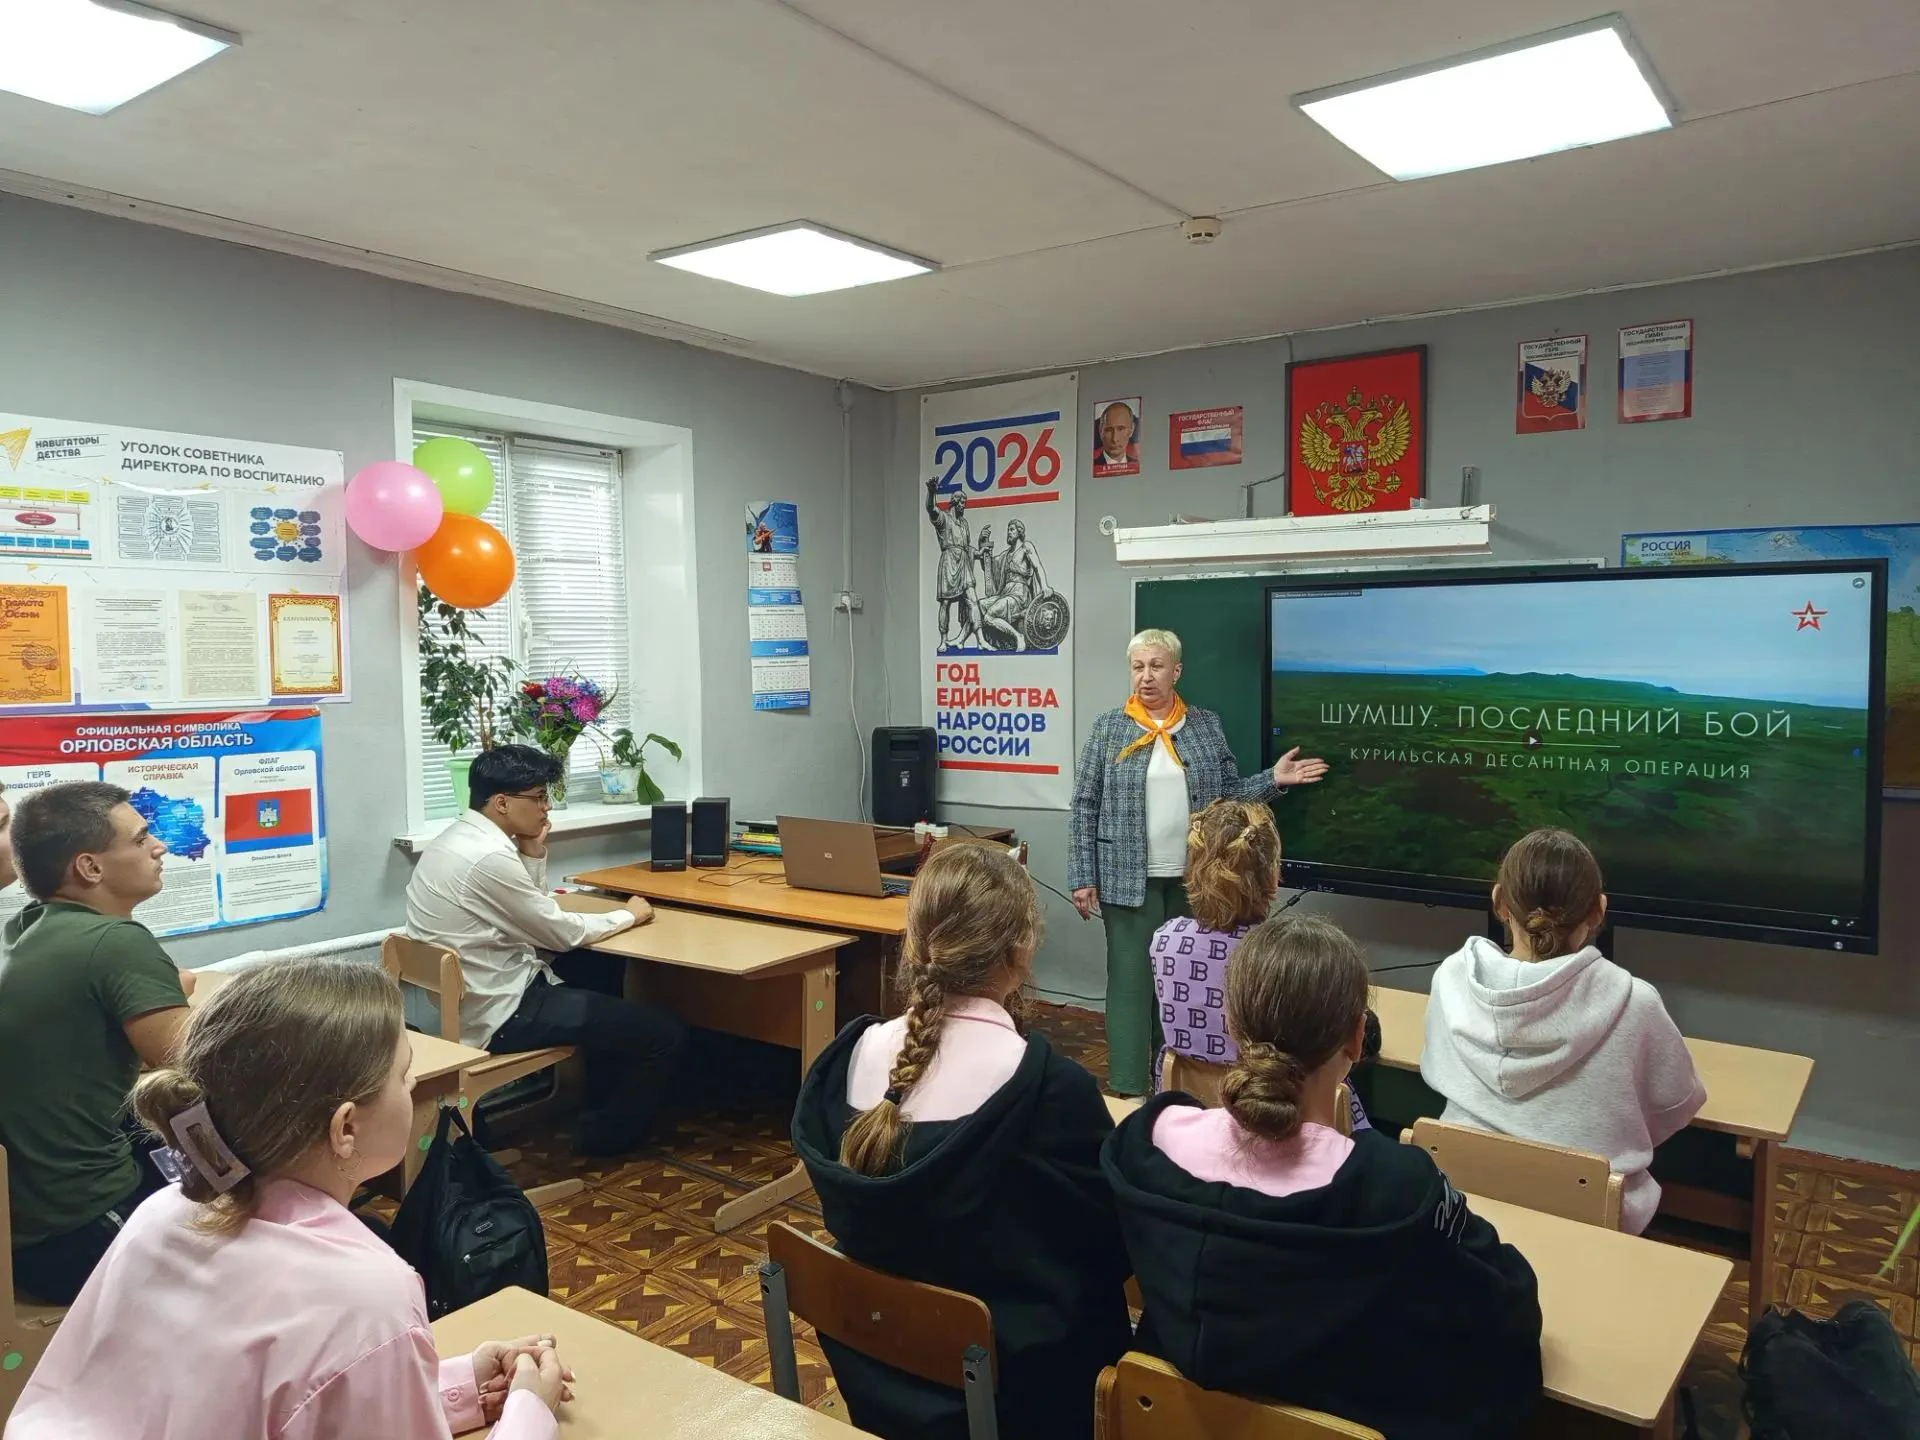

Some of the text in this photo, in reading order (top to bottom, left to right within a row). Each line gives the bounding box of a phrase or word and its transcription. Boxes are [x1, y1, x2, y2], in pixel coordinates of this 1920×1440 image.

[35, 436, 100, 449] НАВИГАТОРЫ
[120, 440, 265, 466] УГОЛОК СОВЕТНИКА
[37, 448, 81, 461] ДЕТСТВА
[935, 428, 1061, 495] 2026
[121, 458, 325, 487] ДИРЕКТОРА ПО ВОСПИТАНИЮ
[1641, 540, 1691, 552] РОССИЯ
[936, 663, 981, 686] ГОД
[936, 687, 1060, 710] ЕДИНСТВА
[76, 721, 242, 737] ОФИЦИАЛЬНАЯ СИМВОЛИКА
[937, 711, 1046, 736] НАРОДОВ
[1320, 703, 1792, 739] ШУМШУ. ПОСЛЕДНИЙ БОЙ
[60, 735, 254, 754] ОРЛОВСКАЯ ОБЛАСТЬ
[937, 734, 1031, 758] РОССИИ
[27, 770, 52, 779] ГЕРБ
[127, 762, 199, 774] ИСТОРИЧЕСКАЯ
[233, 764, 306, 777] Орловской области
[1350, 746, 1751, 780] КУРИЛЬСКАЯ ДЕСАНТНАЯ ОПЕРАЦИЯ
[5, 781, 45, 790] ловской
[143, 771, 185, 782] СПРАВКА
[1156, 935, 1228, 961] B B B
[1162, 956, 1209, 982] B B
[1172, 981, 1224, 1009] B B
[1161, 1003, 1208, 1029] B B
[1172, 1028, 1226, 1056] B B
